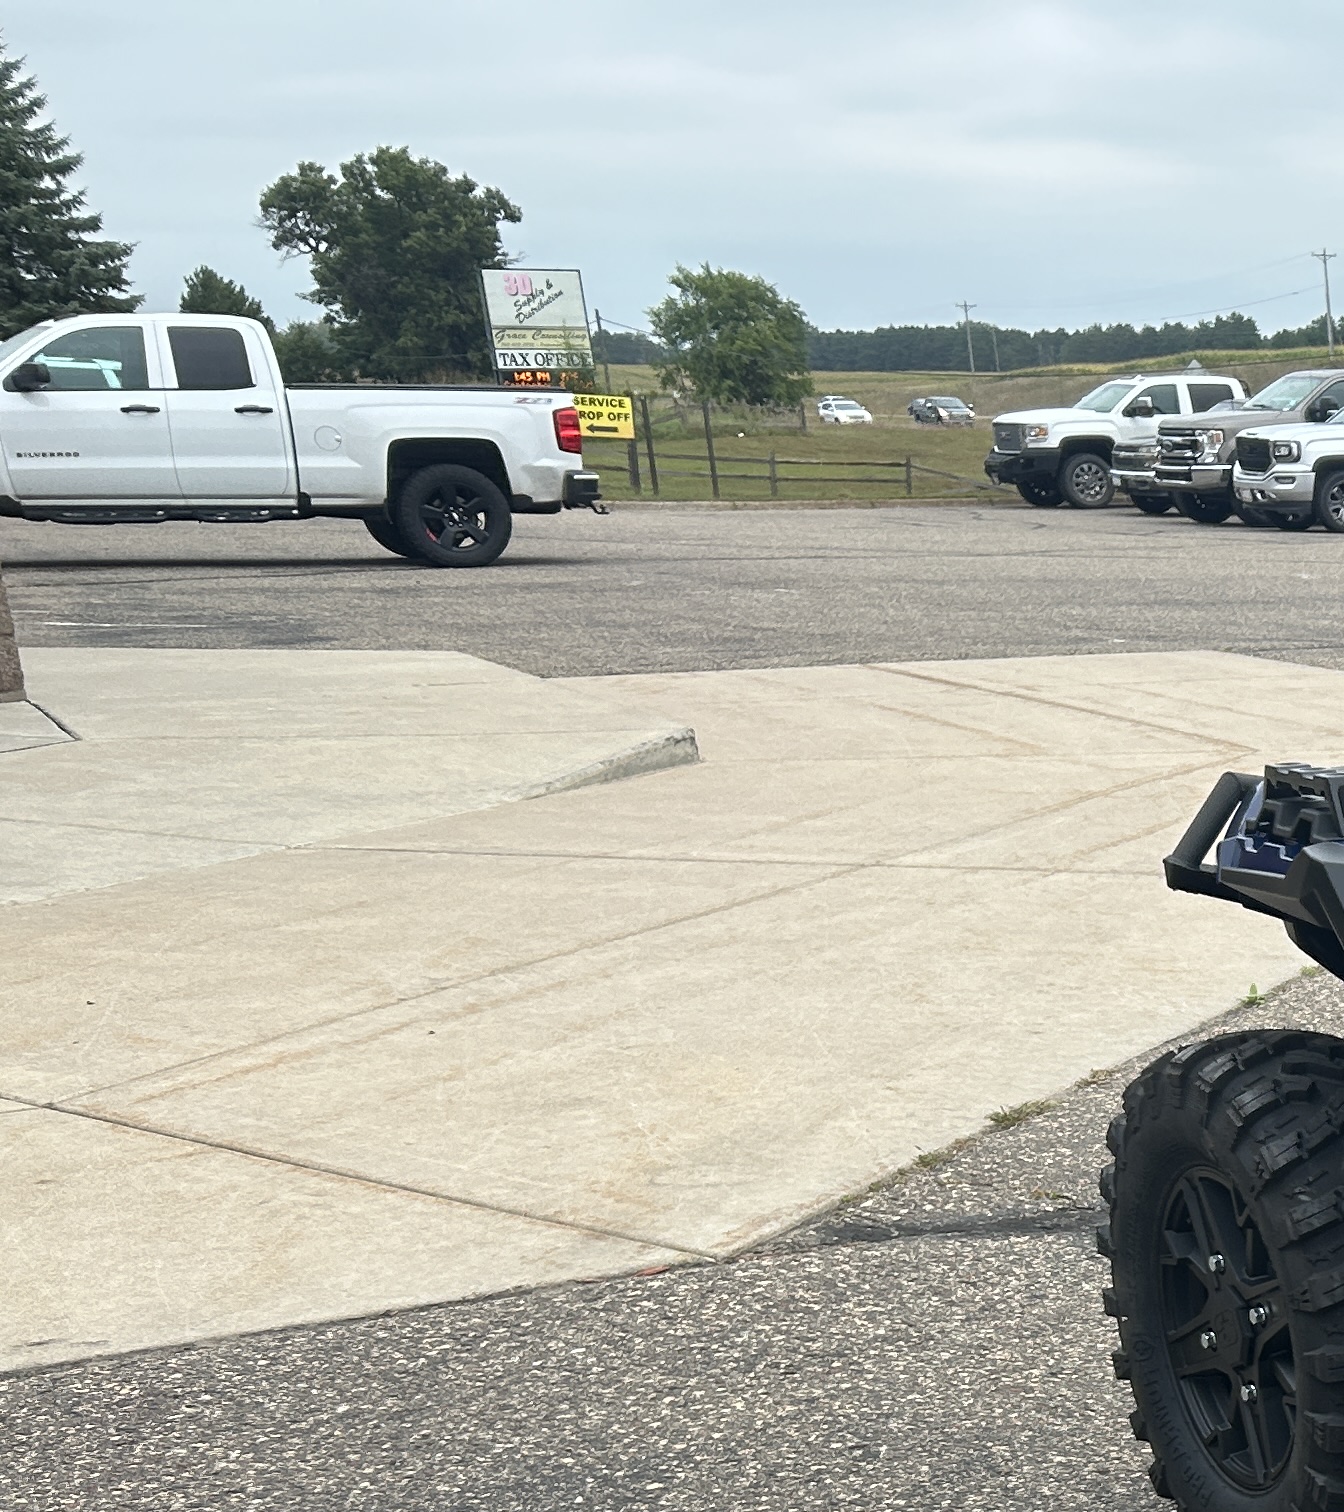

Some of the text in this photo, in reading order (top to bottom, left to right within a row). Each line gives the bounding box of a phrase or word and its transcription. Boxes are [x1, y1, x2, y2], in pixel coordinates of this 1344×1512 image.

[502, 272, 534, 297] 3D
[513, 287, 545, 312] Supply
[514, 289, 564, 324] Distribution
[499, 352, 592, 367] TAX OFFICE
[572, 396, 627, 408] SERVICE
[578, 410, 631, 422] ROP OFF
